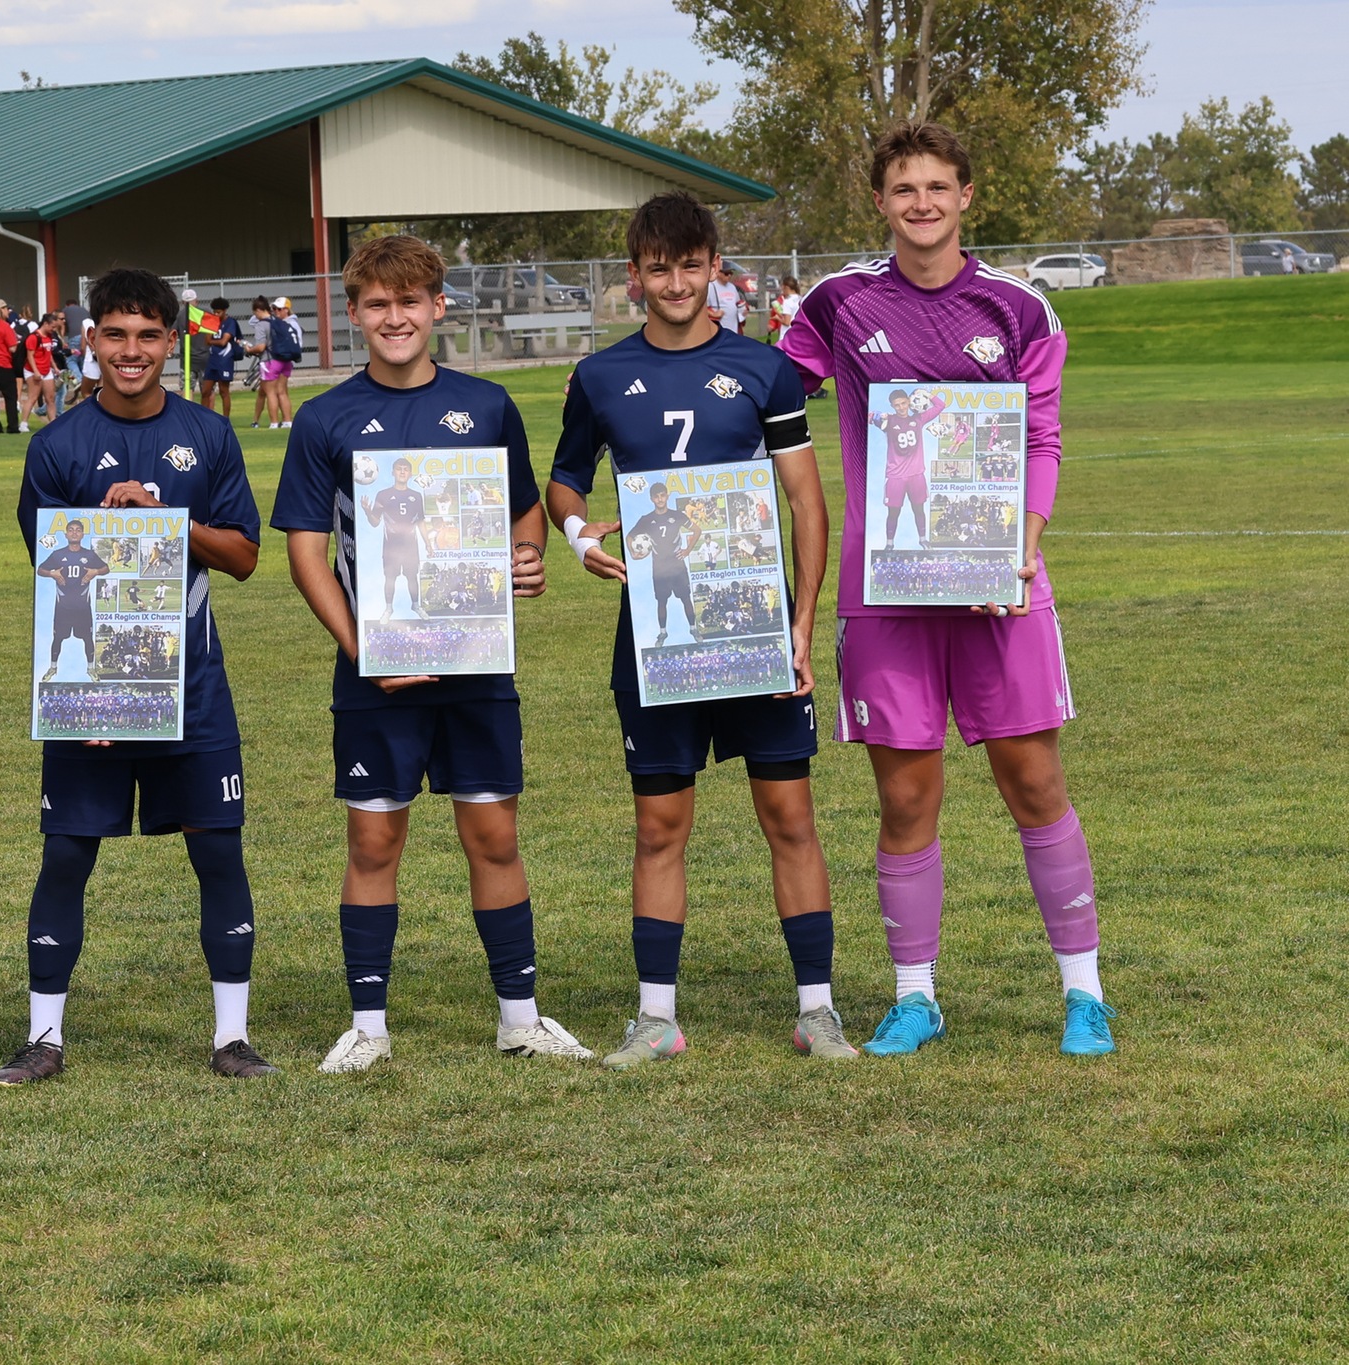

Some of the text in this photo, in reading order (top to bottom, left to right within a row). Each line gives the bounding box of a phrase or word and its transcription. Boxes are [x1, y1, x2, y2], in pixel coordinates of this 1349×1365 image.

[931, 388, 1024, 410] Owen
[663, 410, 695, 462] 7
[897, 430, 917, 448] 99
[403, 451, 505, 475] Yediel
[665, 468, 770, 495] Alvaro
[950, 483, 977, 491] Region
[987, 483, 1019, 491] Champs
[399, 503, 407, 515] 5
[48, 511, 184, 541] Anthony
[659, 526, 667, 537] 7
[449, 551, 472, 559] Region
[481, 550, 508, 558] Champs
[67, 565, 79, 578] 10
[691, 573, 708, 581] 2024
[710, 570, 736, 579] Region
[747, 566, 778, 575] Champs
[114, 614, 140, 622] Region
[151, 613, 181, 621] Champs
[804, 704, 815, 730] 7
[221, 774, 241, 802] 10
